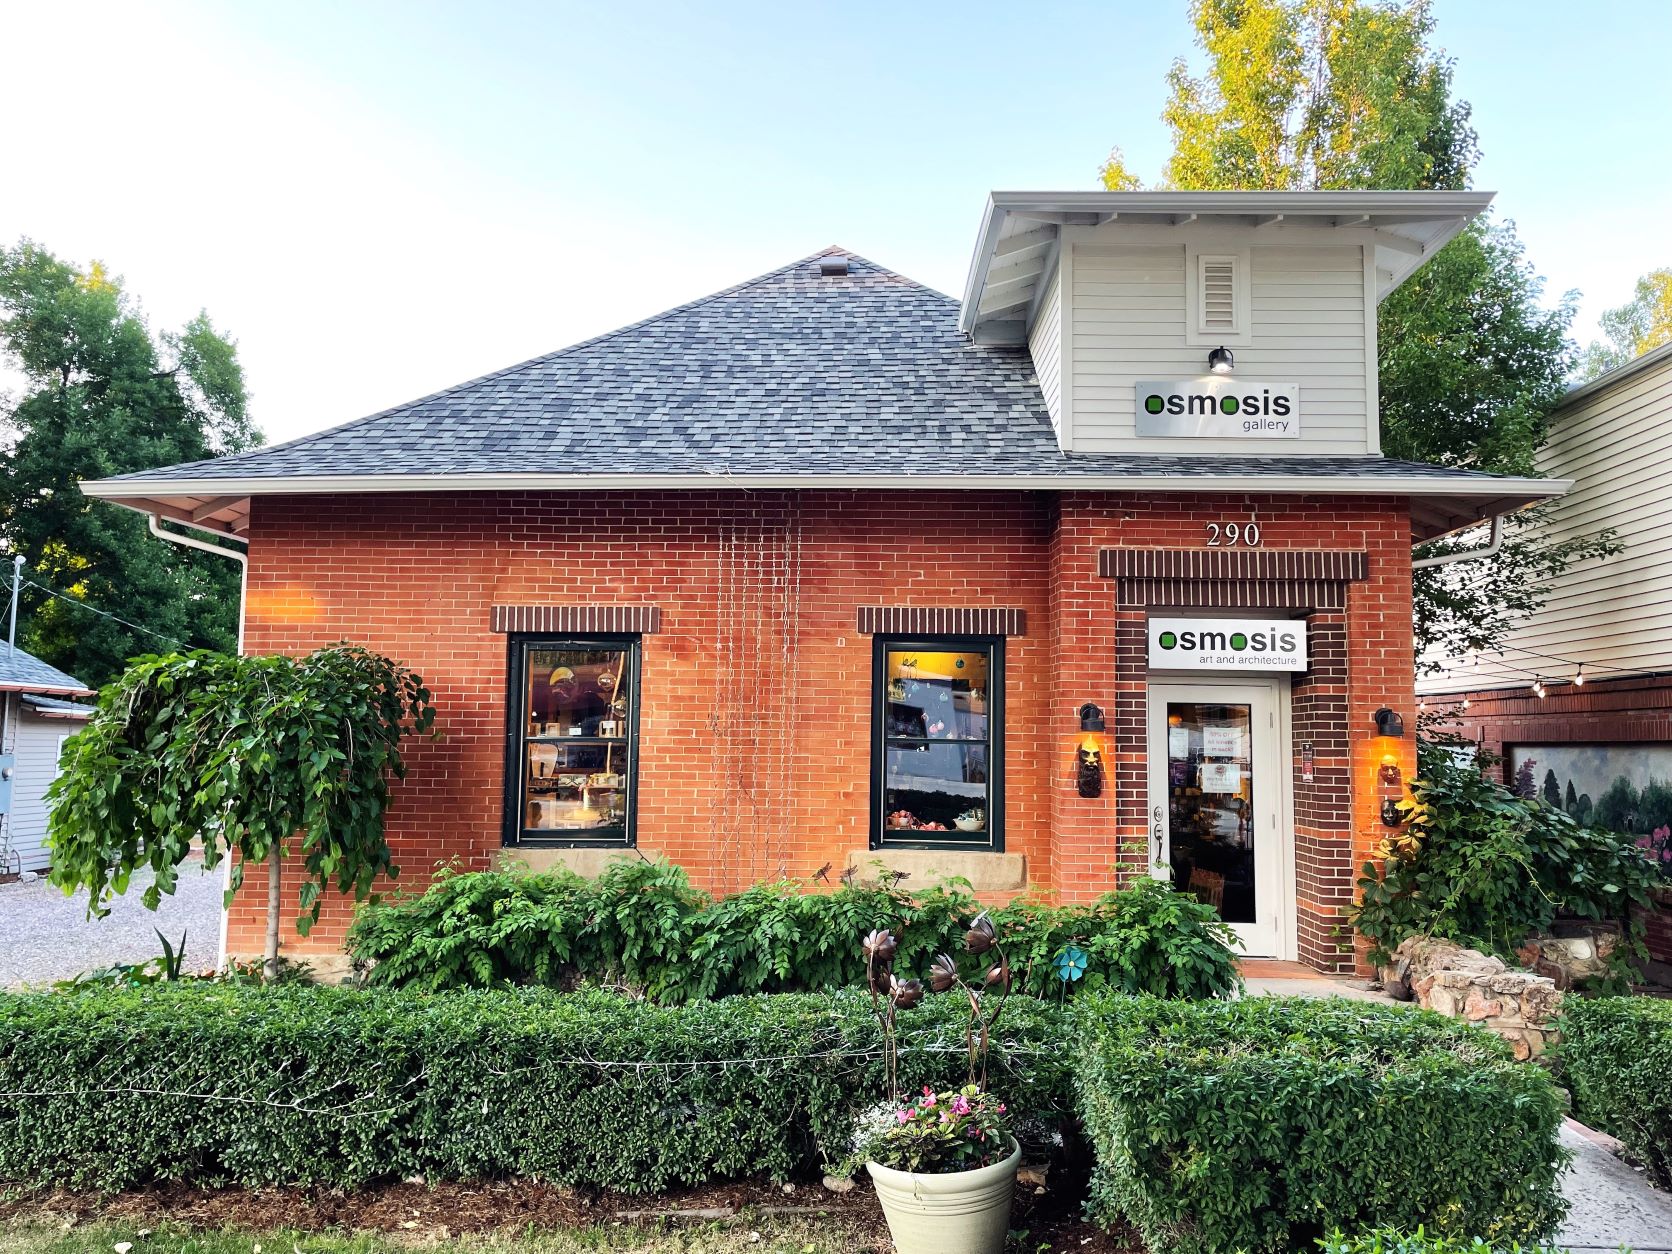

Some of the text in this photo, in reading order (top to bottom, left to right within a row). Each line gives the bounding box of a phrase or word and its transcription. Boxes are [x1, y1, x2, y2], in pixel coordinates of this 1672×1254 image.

[1144, 389, 1291, 416] osmosis
[1243, 418, 1289, 432] gallery
[1206, 523, 1260, 546] 290
[1158, 627, 1297, 653] osmosis
[1199, 655, 1297, 665] art and architecture
